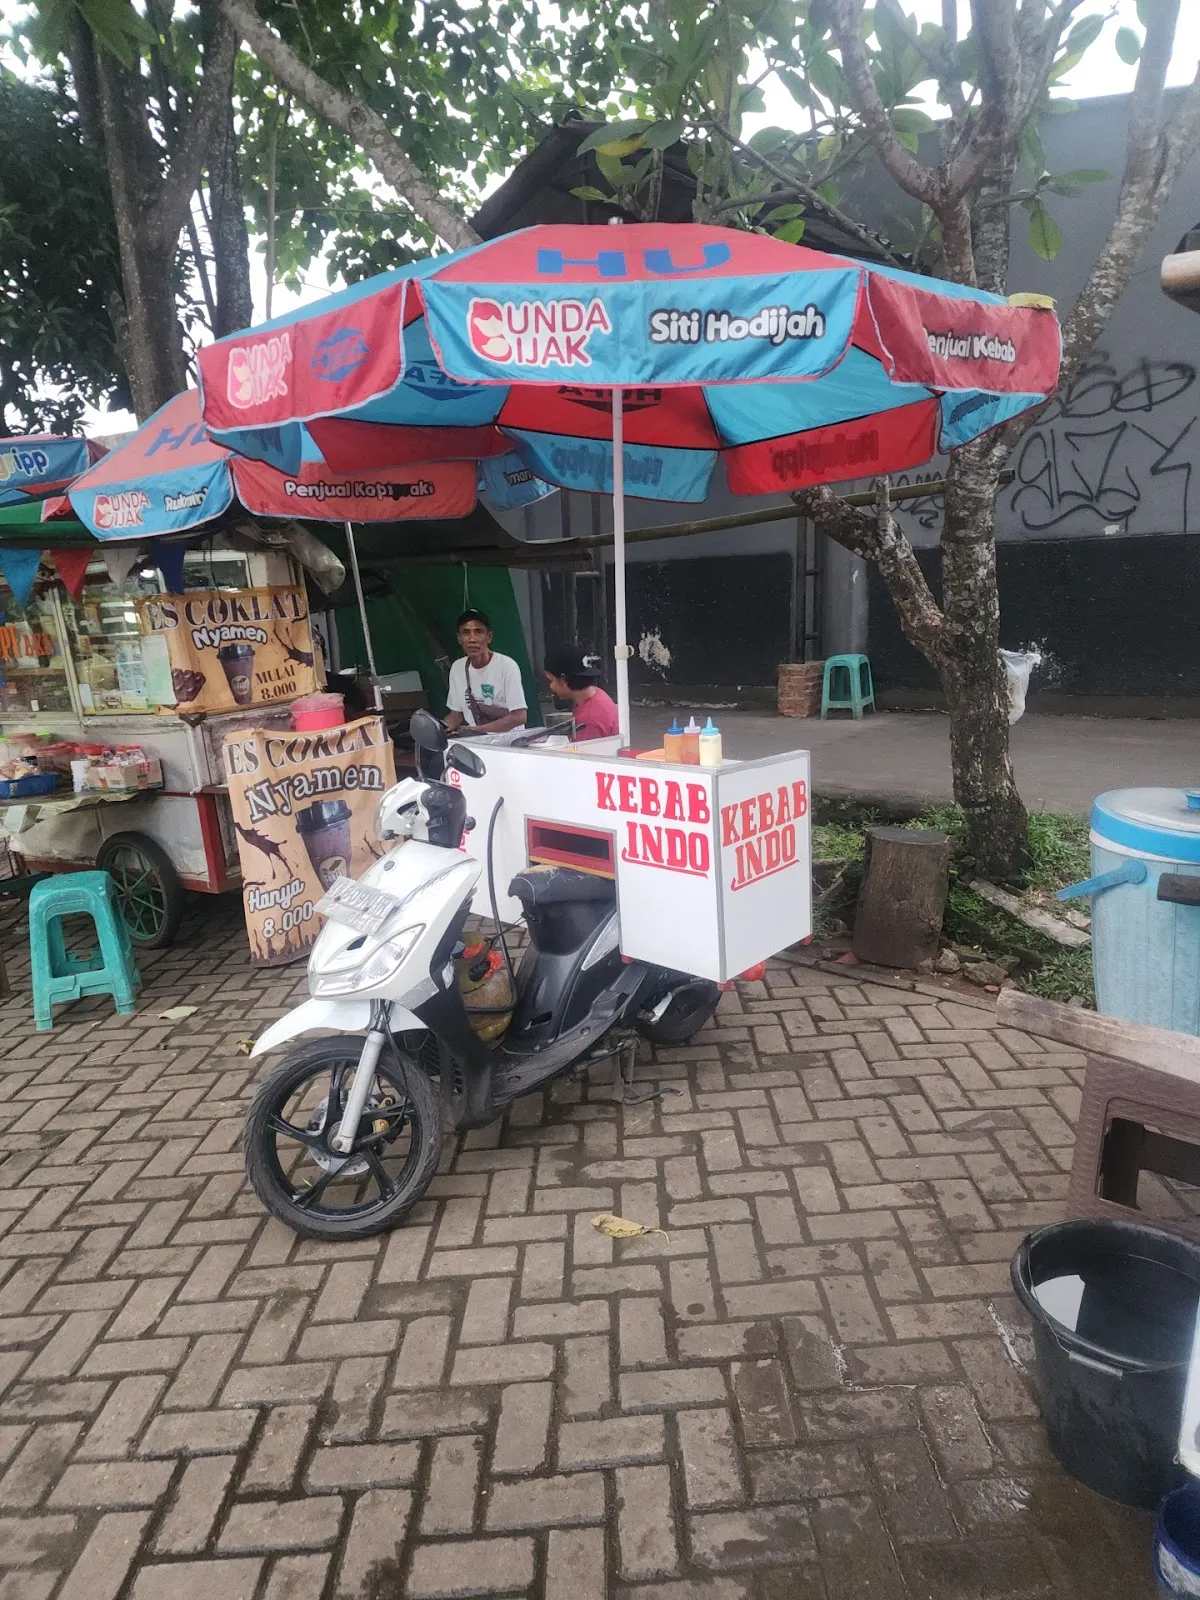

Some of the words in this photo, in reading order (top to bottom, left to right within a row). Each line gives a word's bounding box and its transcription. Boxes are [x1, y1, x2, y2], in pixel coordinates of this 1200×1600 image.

[648, 308, 701, 345] Siti
[704, 303, 825, 346] Hodijah
[921, 327, 971, 360] enjual
[973, 332, 1016, 362] Kebab
[285, 481, 350, 500] Penjual
[146, 602, 181, 632] ES
[184, 592, 308, 626] COKLAT
[192, 624, 268, 650] Nyamen
[255, 664, 296, 686] MULAI
[260, 680, 297, 700] 8.000
[225, 739, 261, 776] ES
[264, 715, 392, 769] COKLAT
[244, 763, 385, 824] Nyamen
[595, 771, 711, 825] KEBAB
[720, 779, 808, 848] KEBAB
[625, 820, 710, 873] INDO
[734, 822, 796, 885] INDO
[249, 878, 305, 914] Hanya
[261, 899, 314, 940] 8.000
